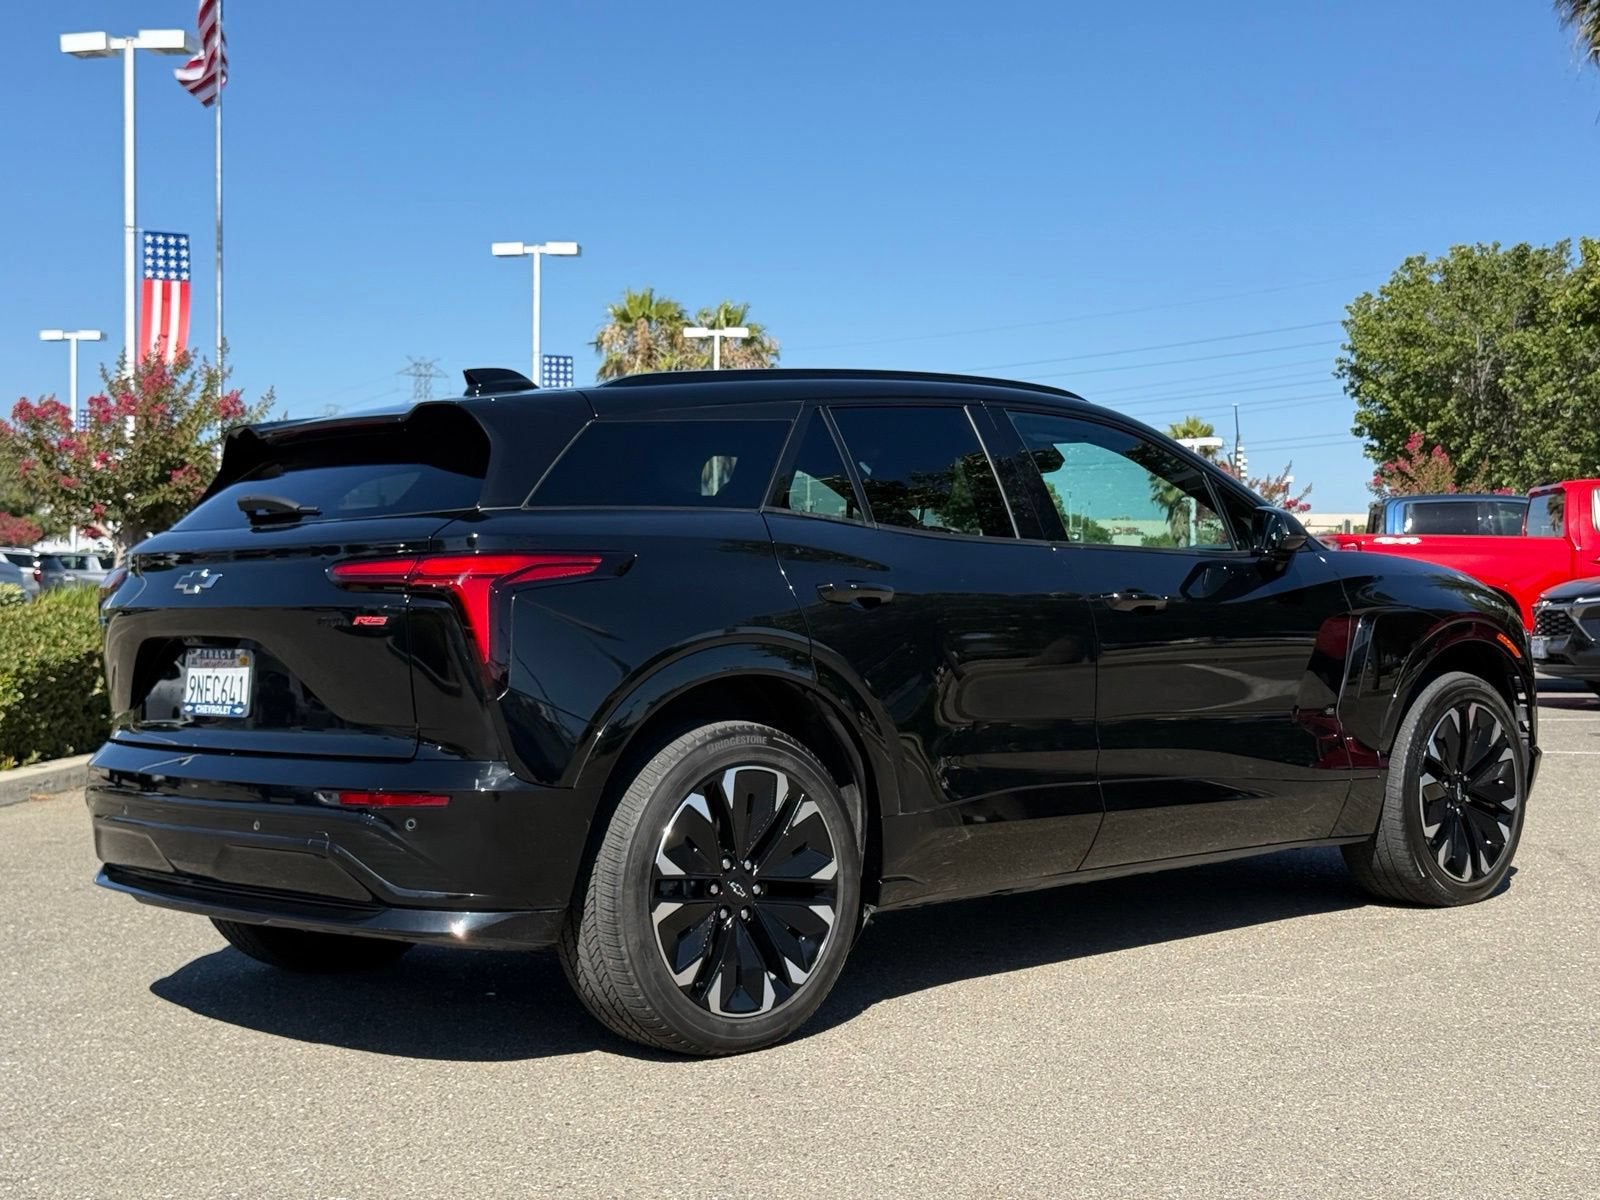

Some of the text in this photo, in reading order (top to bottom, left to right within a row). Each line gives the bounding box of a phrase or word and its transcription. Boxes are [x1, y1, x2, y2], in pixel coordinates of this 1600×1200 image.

[352, 616, 388, 626] RS
[203, 649, 232, 659] TRACY
[188, 675, 244, 704] 9NEC641
[195, 705, 232, 714] CHEVROLET
[706, 735, 768, 755] BRIDGESTONE
